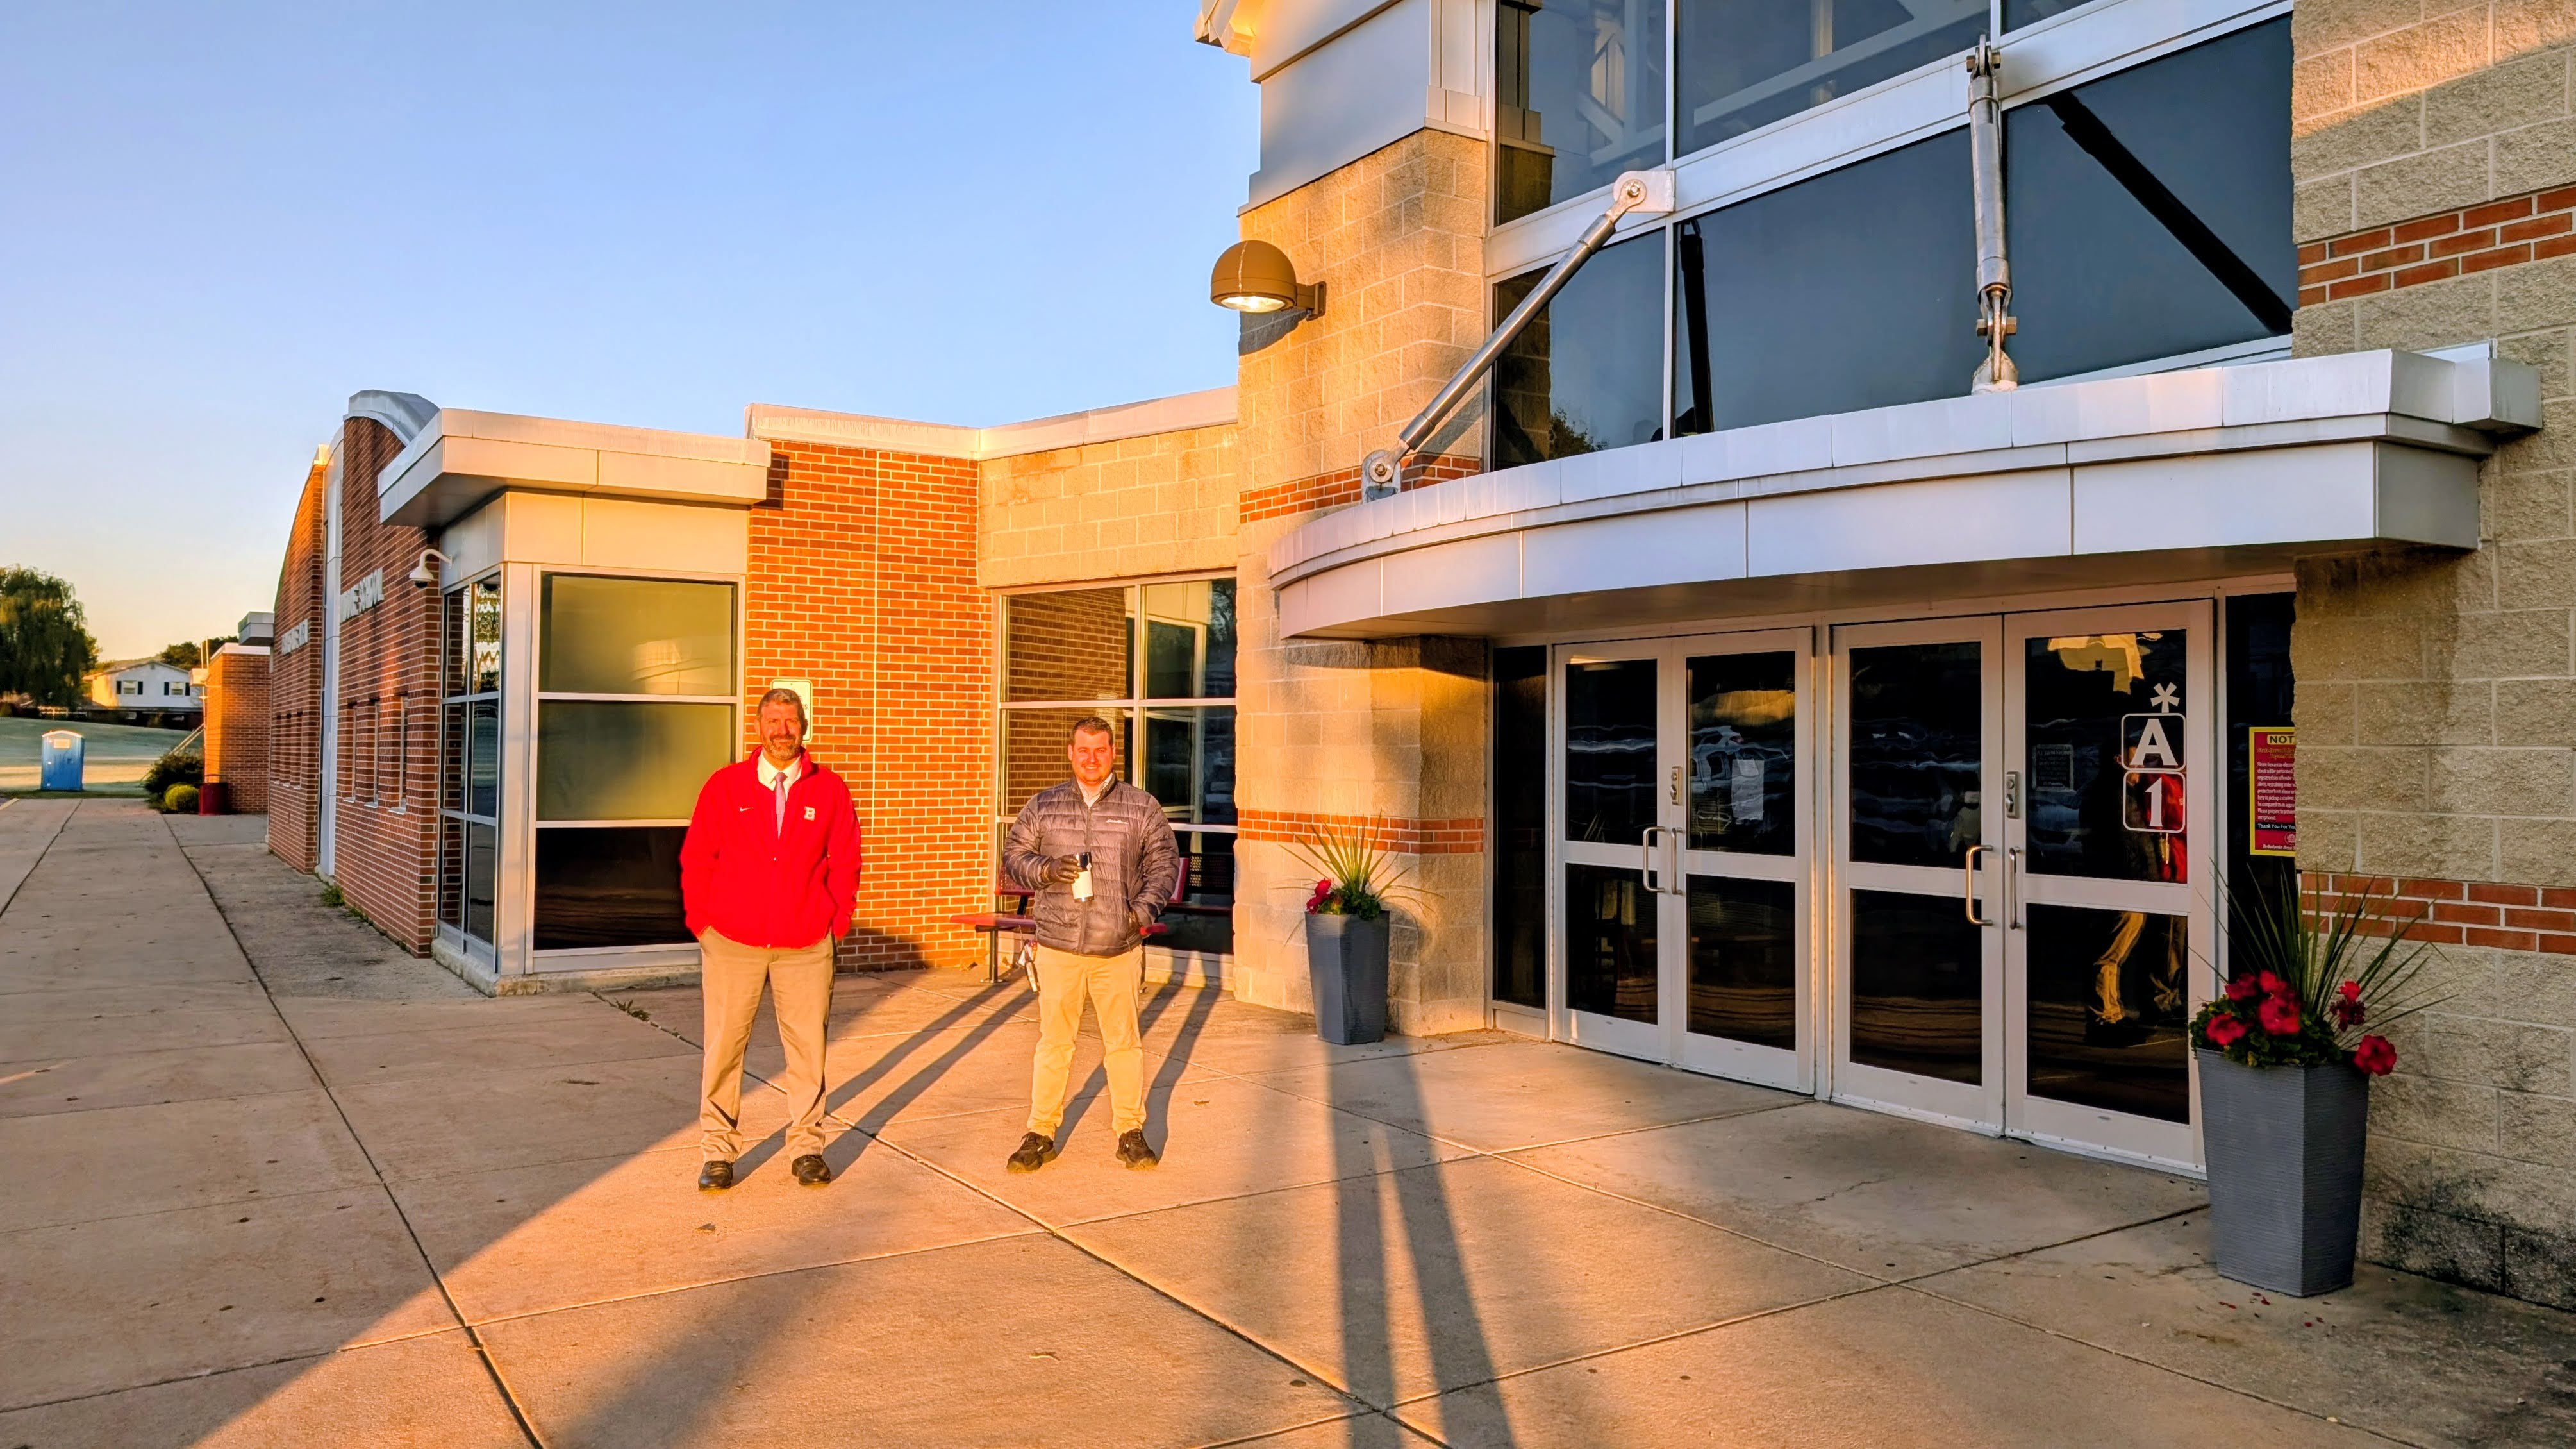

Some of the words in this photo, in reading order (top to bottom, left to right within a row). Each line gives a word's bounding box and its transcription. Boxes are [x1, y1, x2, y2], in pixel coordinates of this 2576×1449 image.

[2129, 718, 2178, 766] A
[804, 805, 815, 821] B
[2145, 776, 2163, 827] 1
